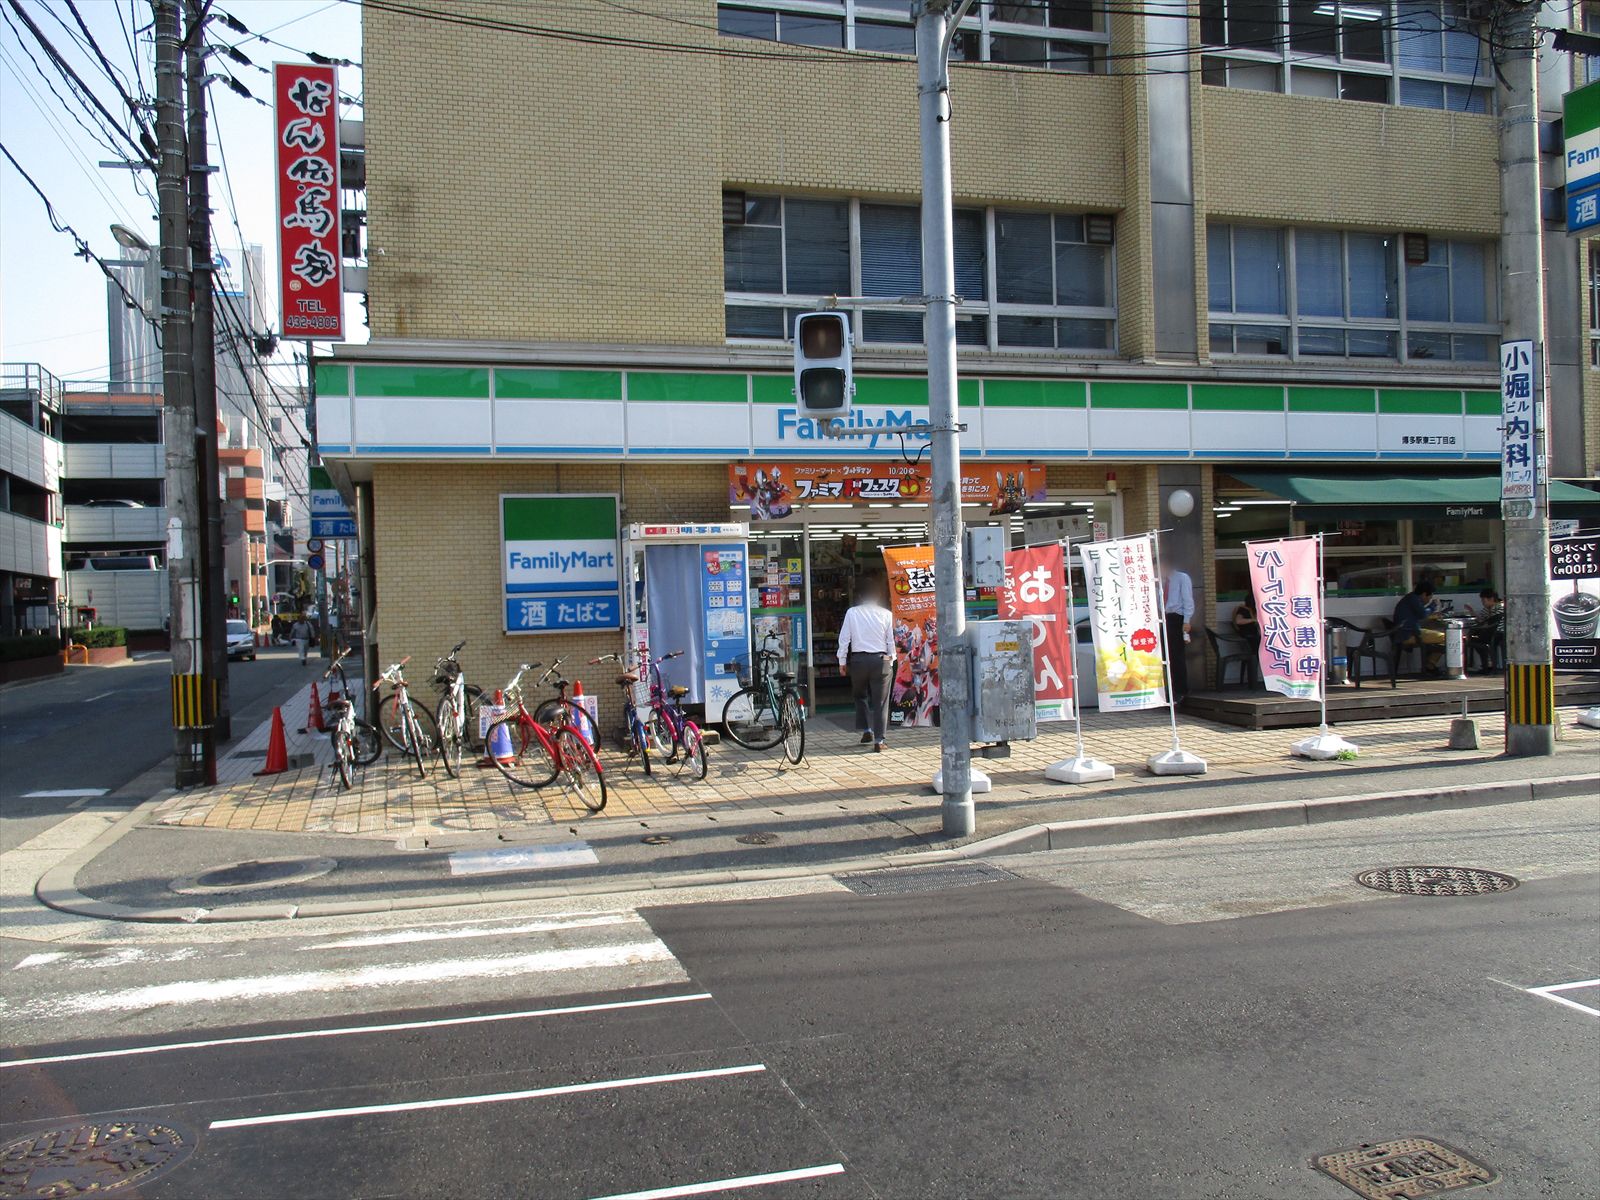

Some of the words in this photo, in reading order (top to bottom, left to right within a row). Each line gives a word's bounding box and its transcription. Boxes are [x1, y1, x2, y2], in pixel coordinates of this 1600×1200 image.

[1576, 194, 1597, 224] 酒
[296, 299, 326, 312] TEL
[287, 316, 338, 329] 432-4805
[1446, 507, 1484, 517] FamilyMart
[510, 552, 614, 573] FamilyMart
[520, 601, 547, 627] 酒
[557, 602, 611, 623] たばこ
